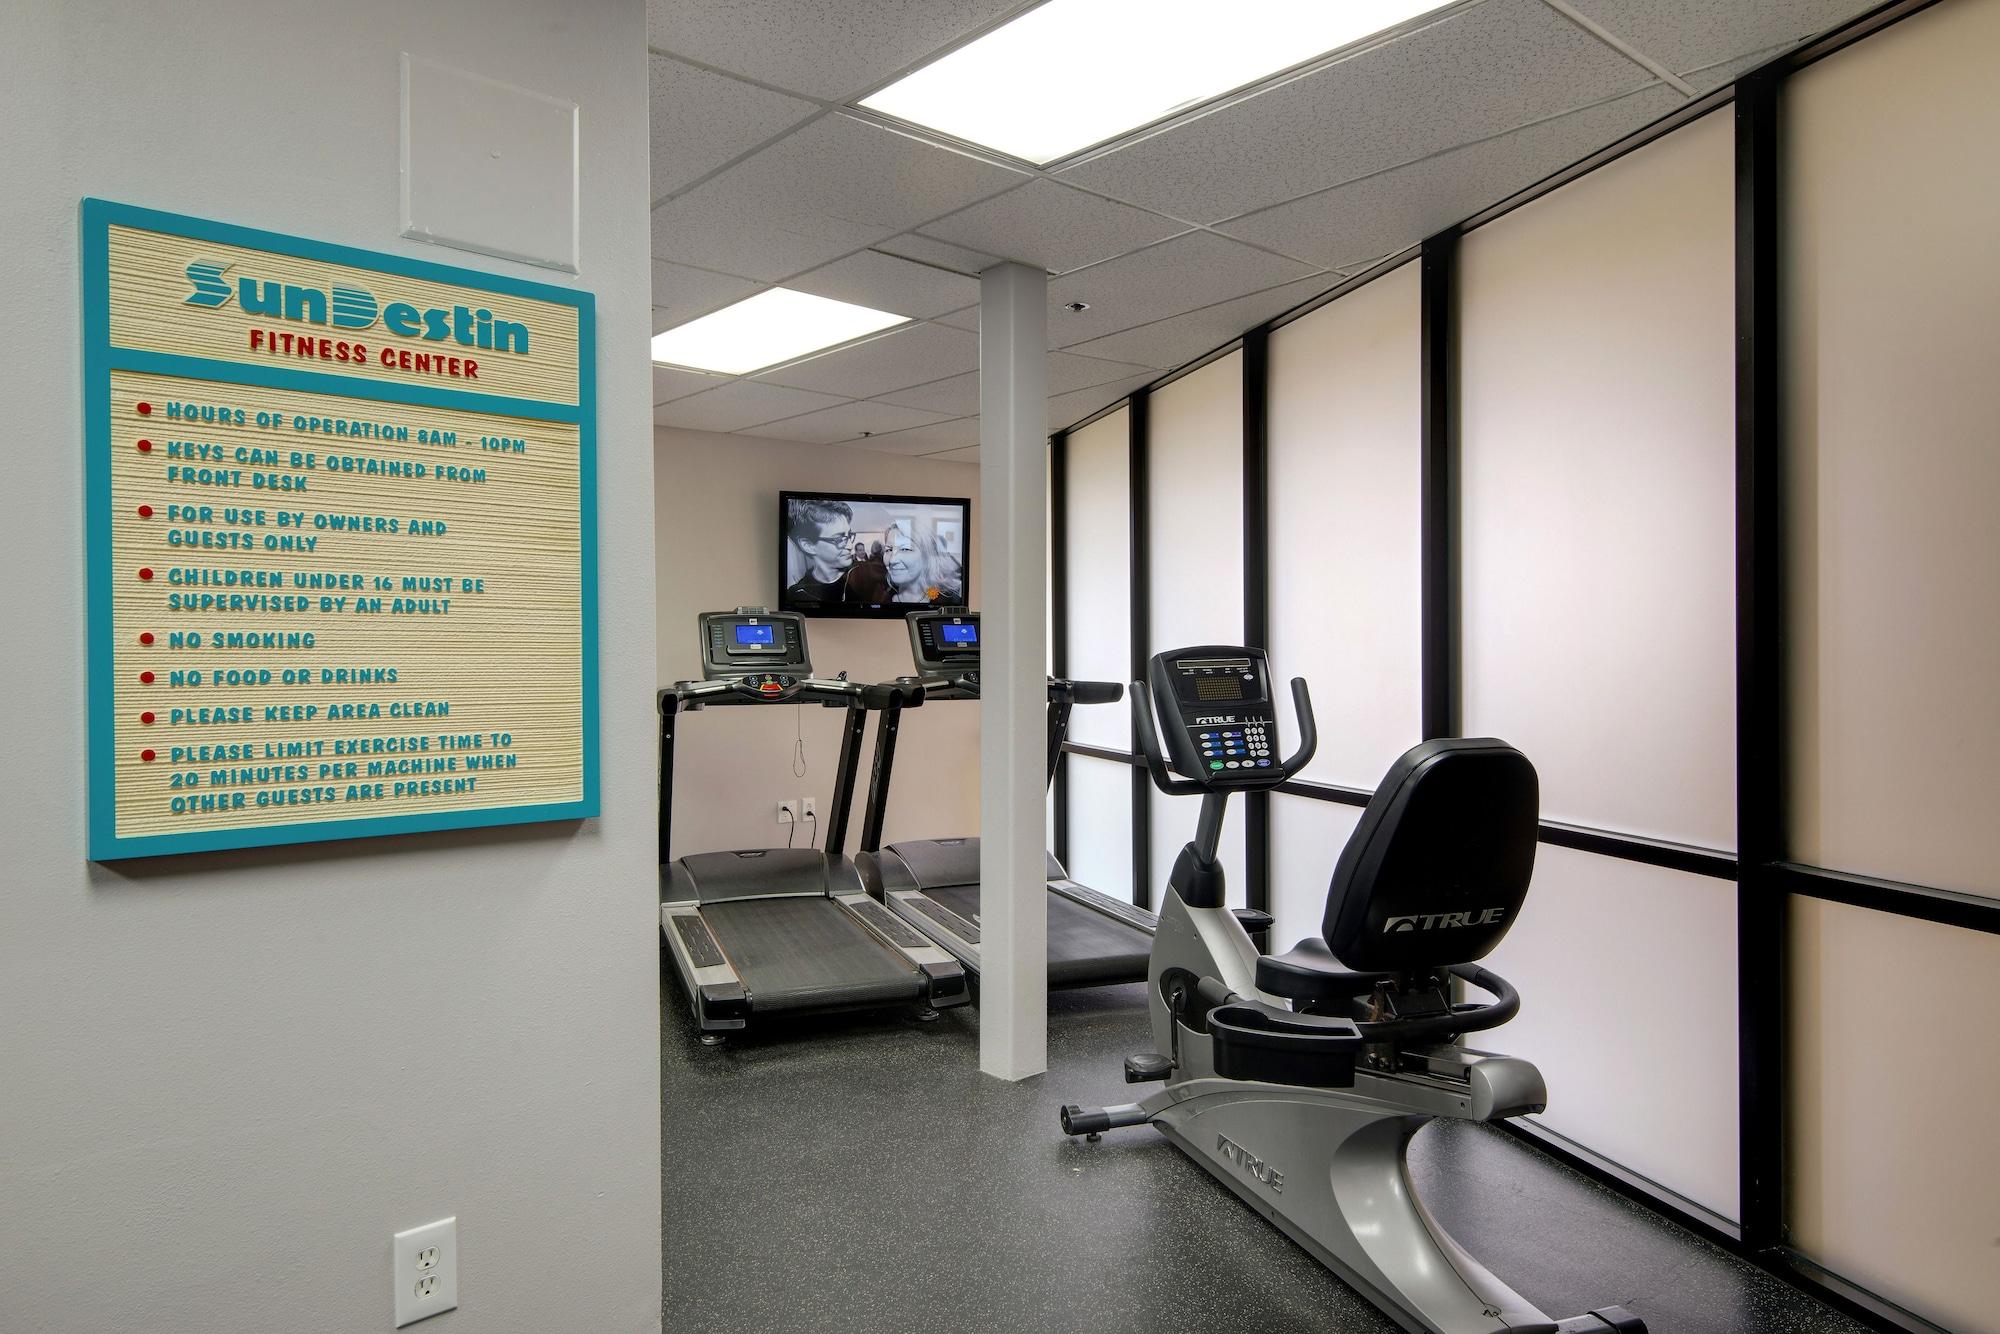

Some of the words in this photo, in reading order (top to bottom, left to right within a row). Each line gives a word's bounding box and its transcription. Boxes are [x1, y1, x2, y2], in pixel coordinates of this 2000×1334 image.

[184, 258, 529, 353] SunDestin
[250, 329, 368, 364] FITNESS
[379, 347, 479, 378] CENTER
[166, 400, 246, 426] HOURS
[255, 411, 283, 428] OF
[293, 415, 409, 442] OPERATION
[417, 428, 457, 446] 8AM
[481, 436, 526, 453] 10PM
[167, 441, 224, 461] KEYS
[234, 447, 279, 466] CAN
[289, 451, 315, 469] BE
[325, 455, 426, 478] OBTAINED
[434, 464, 487, 482] FROM
[167, 465, 241, 486] FRONT
[252, 472, 307, 491] DESK
[167, 503, 213, 523] FOR
[223, 508, 265, 526] USE
[276, 511, 305, 529] BY
[313, 512, 399, 534] OWNERS
[407, 519, 447, 536] AND
[167, 528, 254, 550] GUESTS
[263, 534, 317, 552] ONLY
[167, 567, 284, 587] CHILDREN
[293, 572, 364, 590] UNDER
[374, 575, 393, 591] 16
[401, 576, 452, 593] MUST
[461, 577, 483, 594] BE
[169, 592, 310, 611] SUPERVISED
[319, 595, 346, 612] BY
[355, 596, 383, 613] AN
[391, 596, 449, 614] ADULT
[168, 631, 202, 649] NO
[213, 631, 315, 648] SMOKING
[169, 669, 203, 687] NO
[212, 668, 273, 686] FOOD
[281, 667, 311, 685] OR
[320, 667, 398, 684] DRINKS
[170, 706, 252, 725] PLEASE
[264, 704, 318, 722] KEEP
[327, 703, 381, 721] AREA
[389, 701, 450, 718] CLEAN
[1206, 715, 1236, 724] TRUE
[170, 743, 252, 764] PLEASE
[264, 740, 324, 759] LIMIT
[334, 735, 428, 756] EXERCISE
[438, 733, 481, 749] TIME
[491, 731, 512, 747] TO
[171, 772, 199, 789] 20
[210, 764, 309, 786] MINUTES
[319, 761, 358, 779] PER
[367, 756, 456, 777] MACHINE
[465, 753, 518, 770] WHEN
[170, 793, 246, 813] OTHER
[255, 786, 336, 807] GUESTS
[345, 782, 383, 801] ARE
[393, 776, 476, 797] PRESENT
[1419, 907, 1505, 930] TRUE
[1232, 1142, 1284, 1194] TRUE
